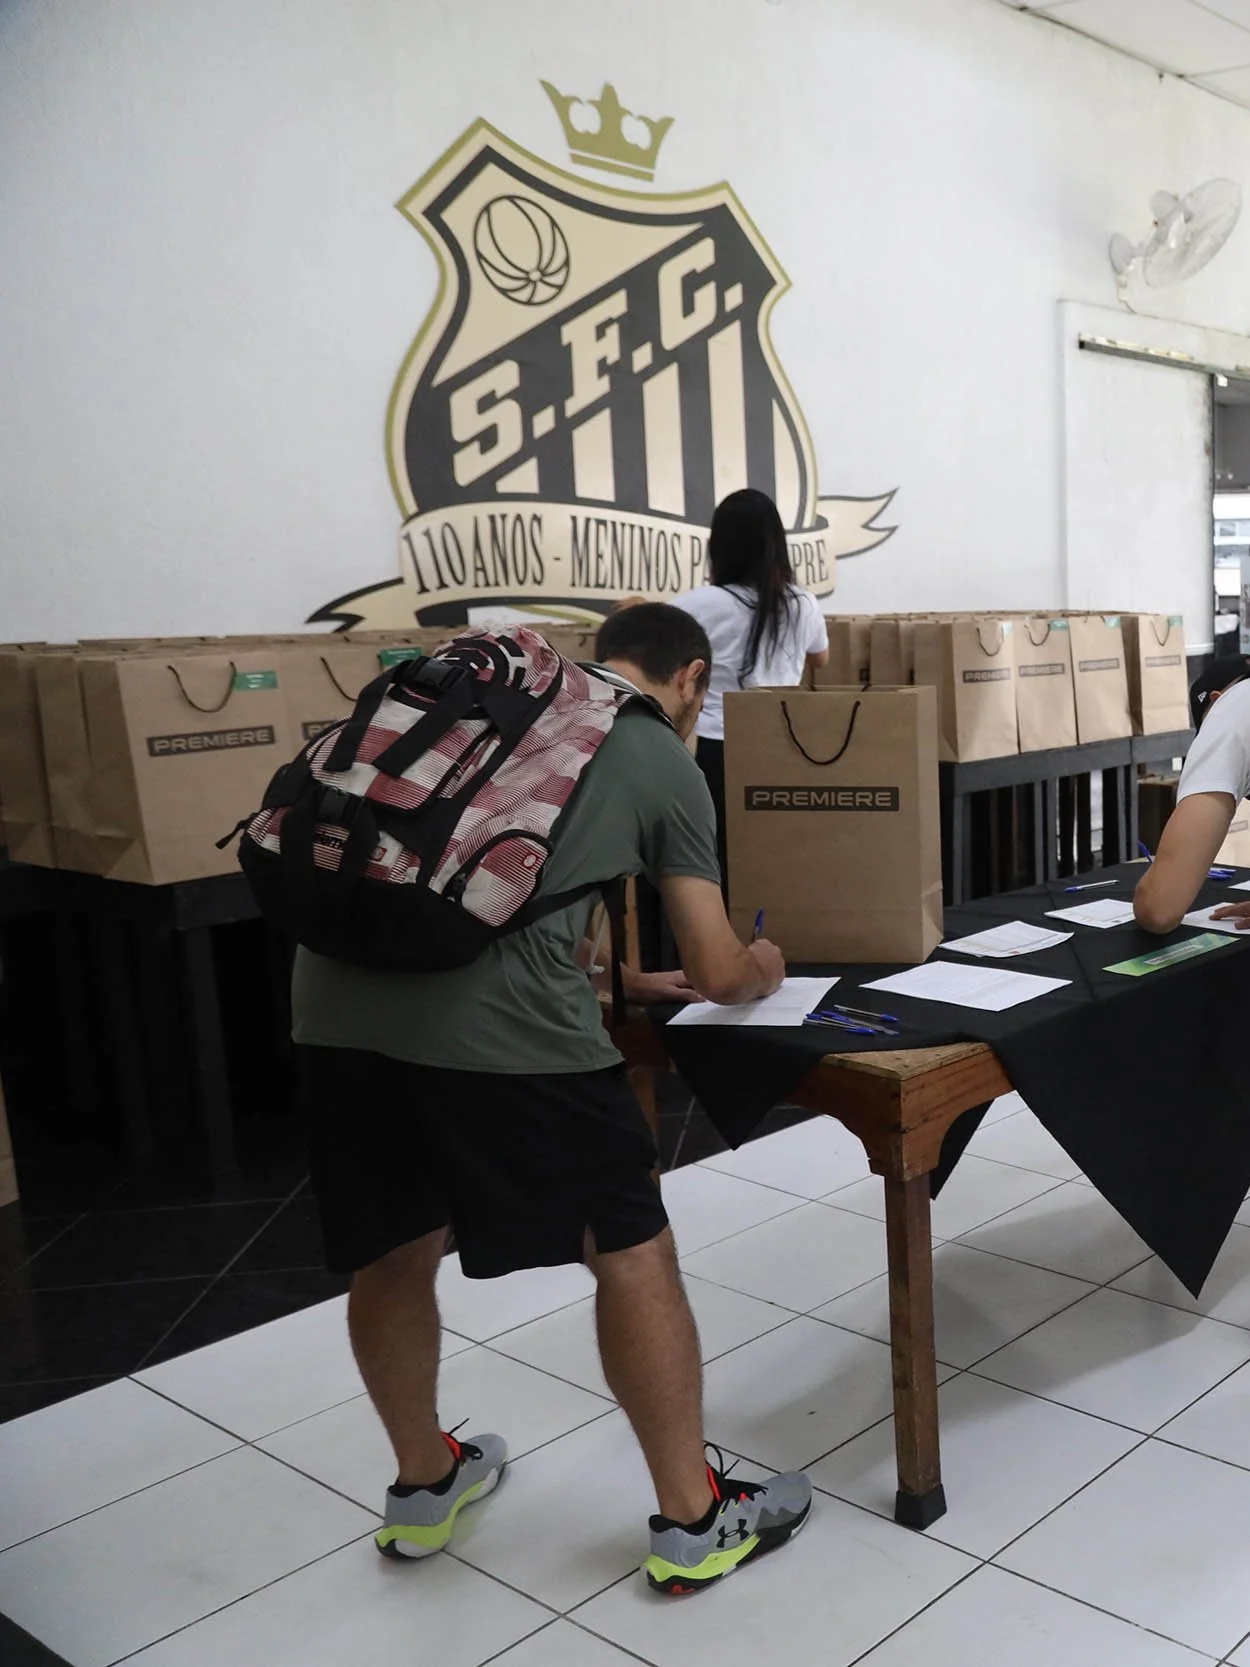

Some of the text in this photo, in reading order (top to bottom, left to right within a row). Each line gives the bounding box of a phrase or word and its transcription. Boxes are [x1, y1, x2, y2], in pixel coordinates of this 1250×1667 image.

[401, 522, 467, 595] 110
[472, 513, 545, 589] ANOS
[570, 515, 681, 593] MENINOS
[790, 539, 829, 586] PRE
[154, 729, 271, 753] PREMIERE
[752, 791, 892, 807] PREMIERE
